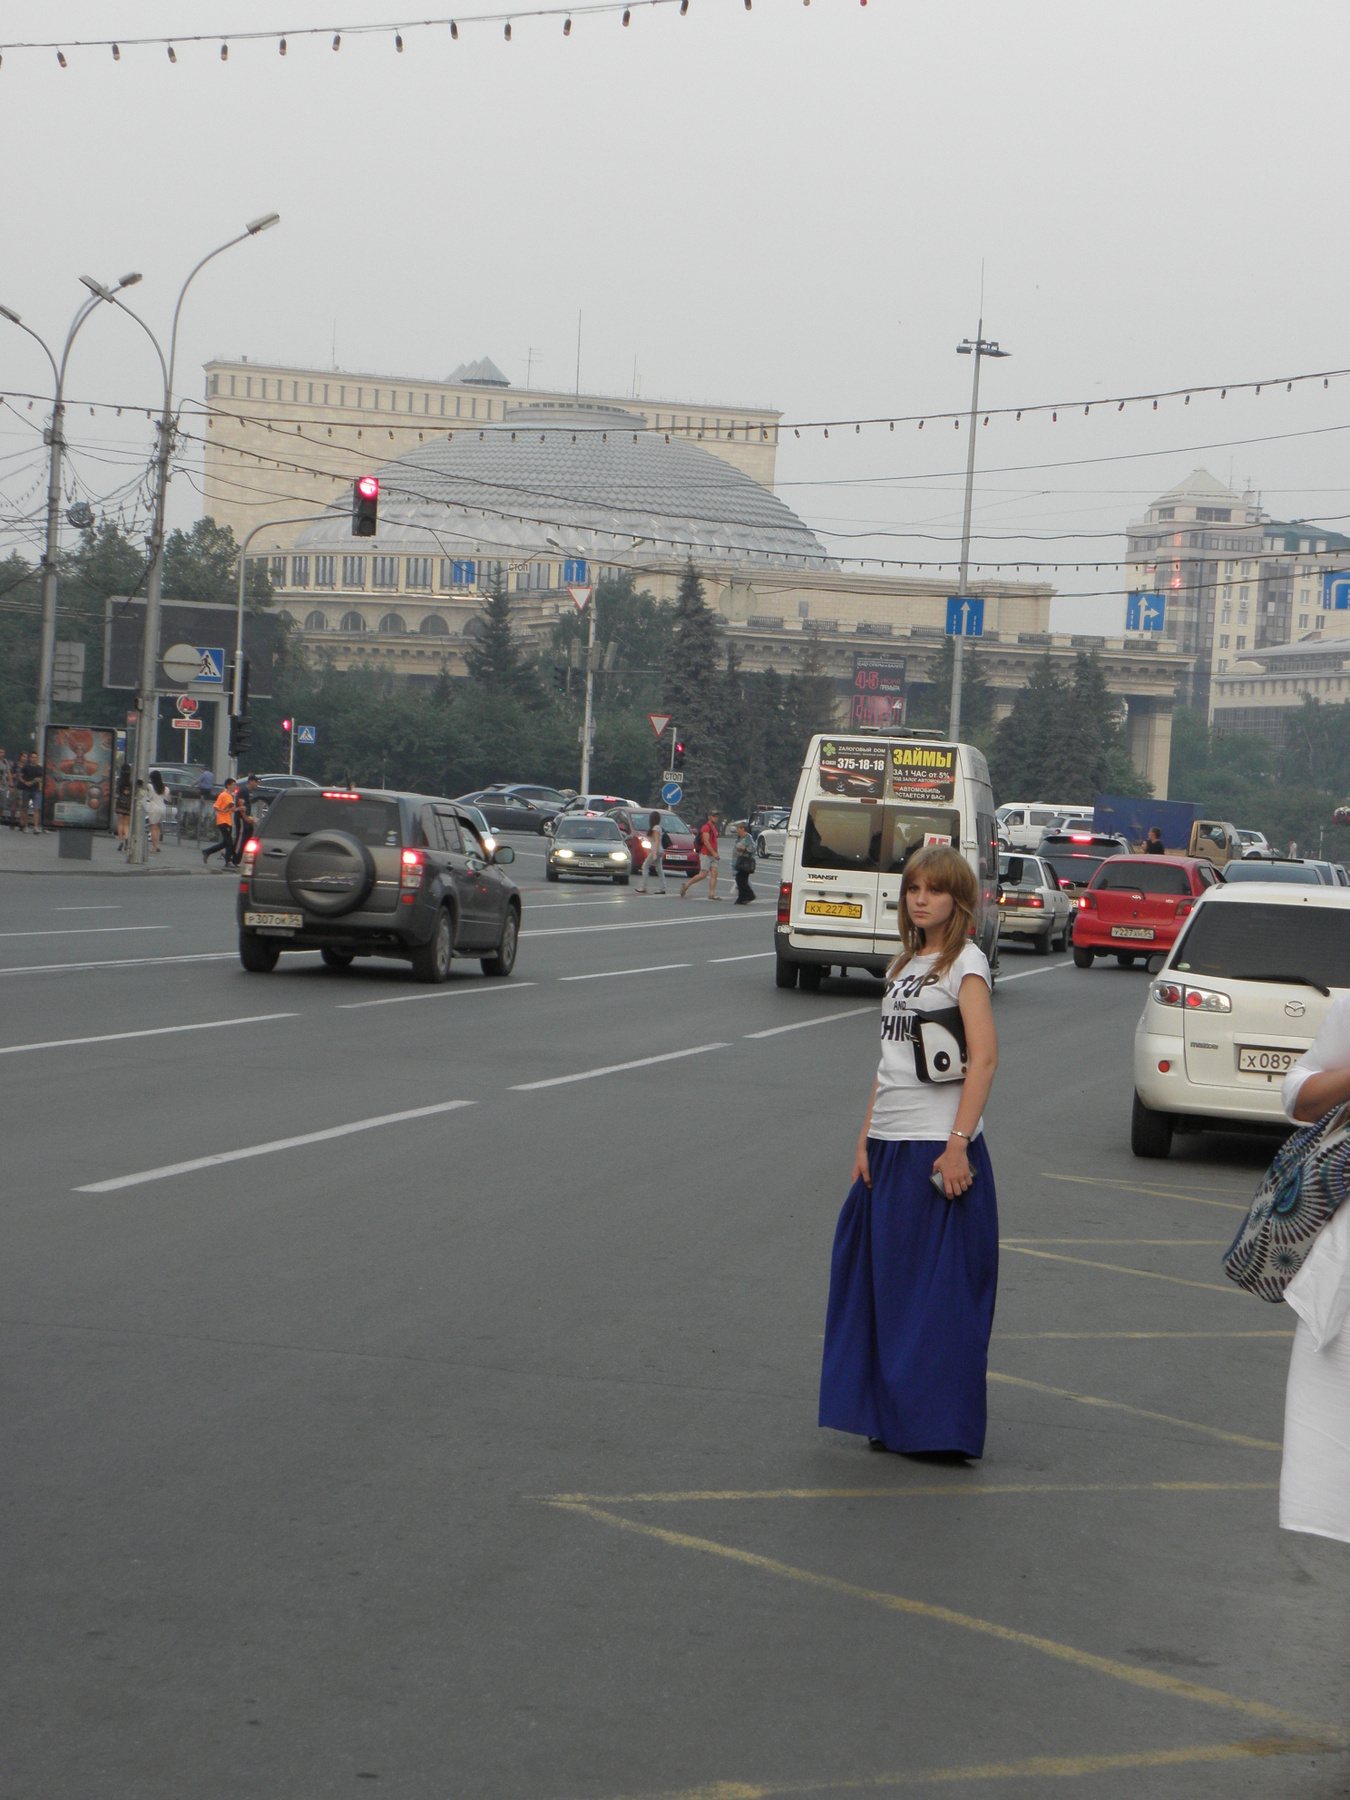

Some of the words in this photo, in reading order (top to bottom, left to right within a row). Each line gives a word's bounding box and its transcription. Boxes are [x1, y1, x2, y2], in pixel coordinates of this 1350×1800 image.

[509, 563, 528, 571] СТОП
[893, 747, 952, 768] ЗАЙМЫ
[837, 757, 885, 771] 375-18-18
[665, 772, 682, 781] СТОП
[900, 786, 941, 794] АВТОМОБИЛЬ
[807, 873, 838, 881] TRANSIT
[893, 1000, 907, 1011] AND
